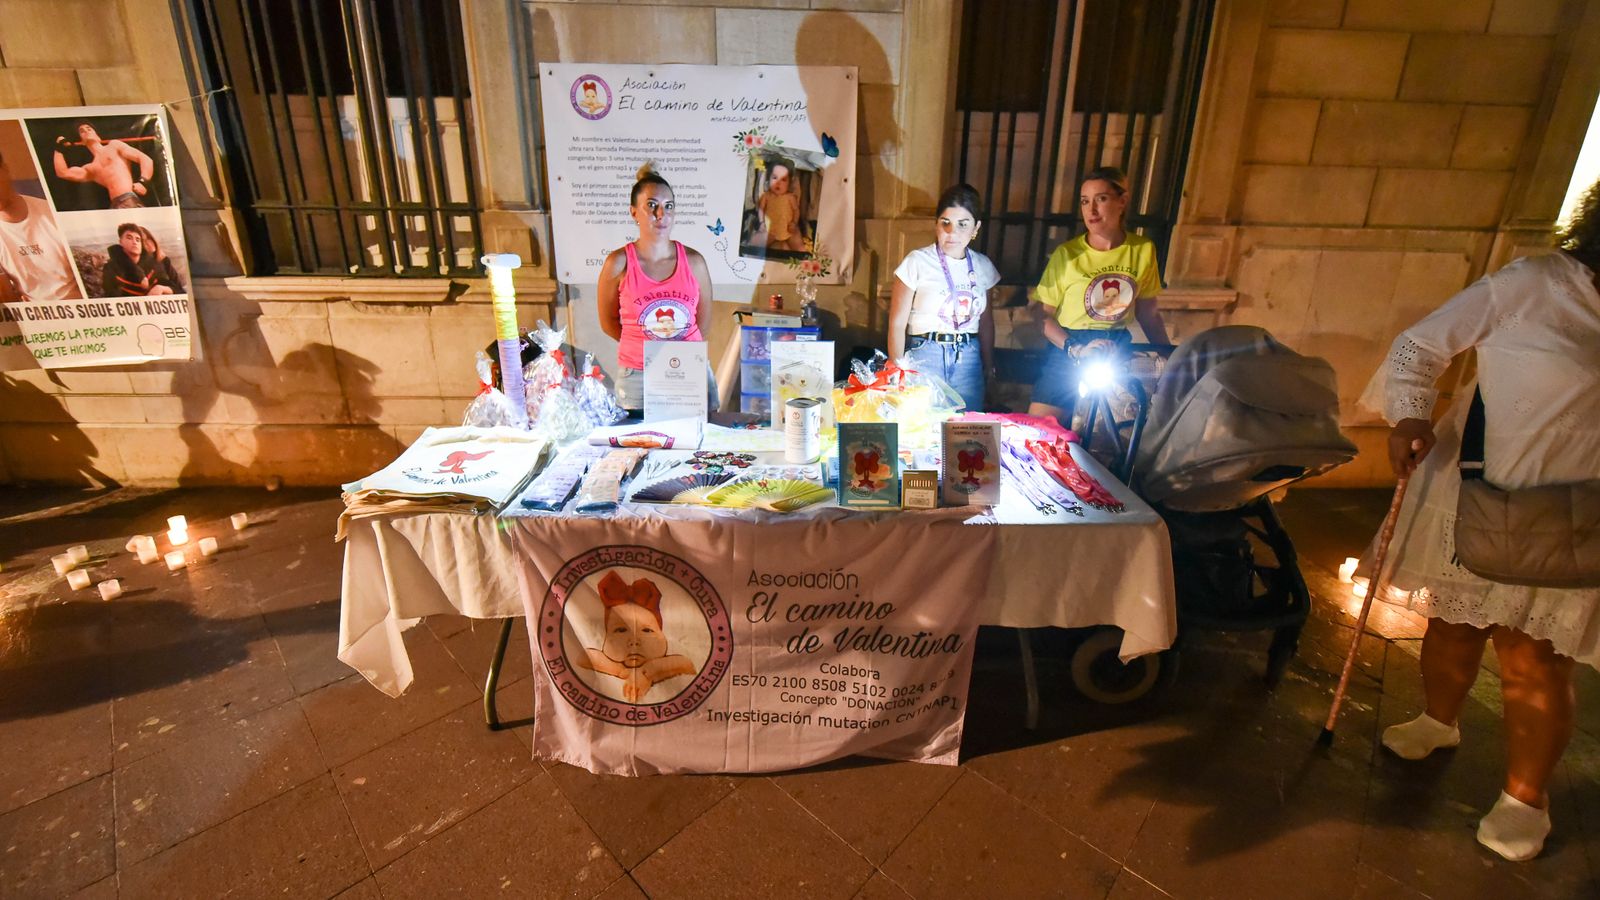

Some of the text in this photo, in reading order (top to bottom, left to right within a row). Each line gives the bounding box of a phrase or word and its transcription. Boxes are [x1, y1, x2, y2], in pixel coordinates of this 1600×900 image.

[618, 95, 808, 112] El camino de Valentina
[634, 290, 697, 306] Valentina
[25, 305, 75, 321] CARLOS
[78, 303, 115, 319] SIGUE
[116, 301, 143, 317] CON
[145, 299, 188, 315] NOSOTR
[68, 329, 82, 340] LA
[84, 326, 128, 339] PROMESA
[34, 343, 107, 359] QUE TE HICIMOS
[451, 470, 498, 485] Valentina
[553, 549, 677, 594] Investigación
[689, 575, 719, 619] Cura
[745, 591, 897, 624] El camino
[786, 624, 964, 659] de Valentina
[819, 662, 881, 681] Colabora
[547, 656, 726, 722] El camino de Valentina
[732, 675, 768, 688] ES70
[772, 676, 807, 689] 2100
[812, 678, 847, 693] 8508
[852, 682, 886, 698] 5102
[892, 683, 925, 699] 0024
[780, 691, 838, 707] Concepto
[706, 708, 812, 727] Investigación
[818, 714, 890, 730] mutacion
